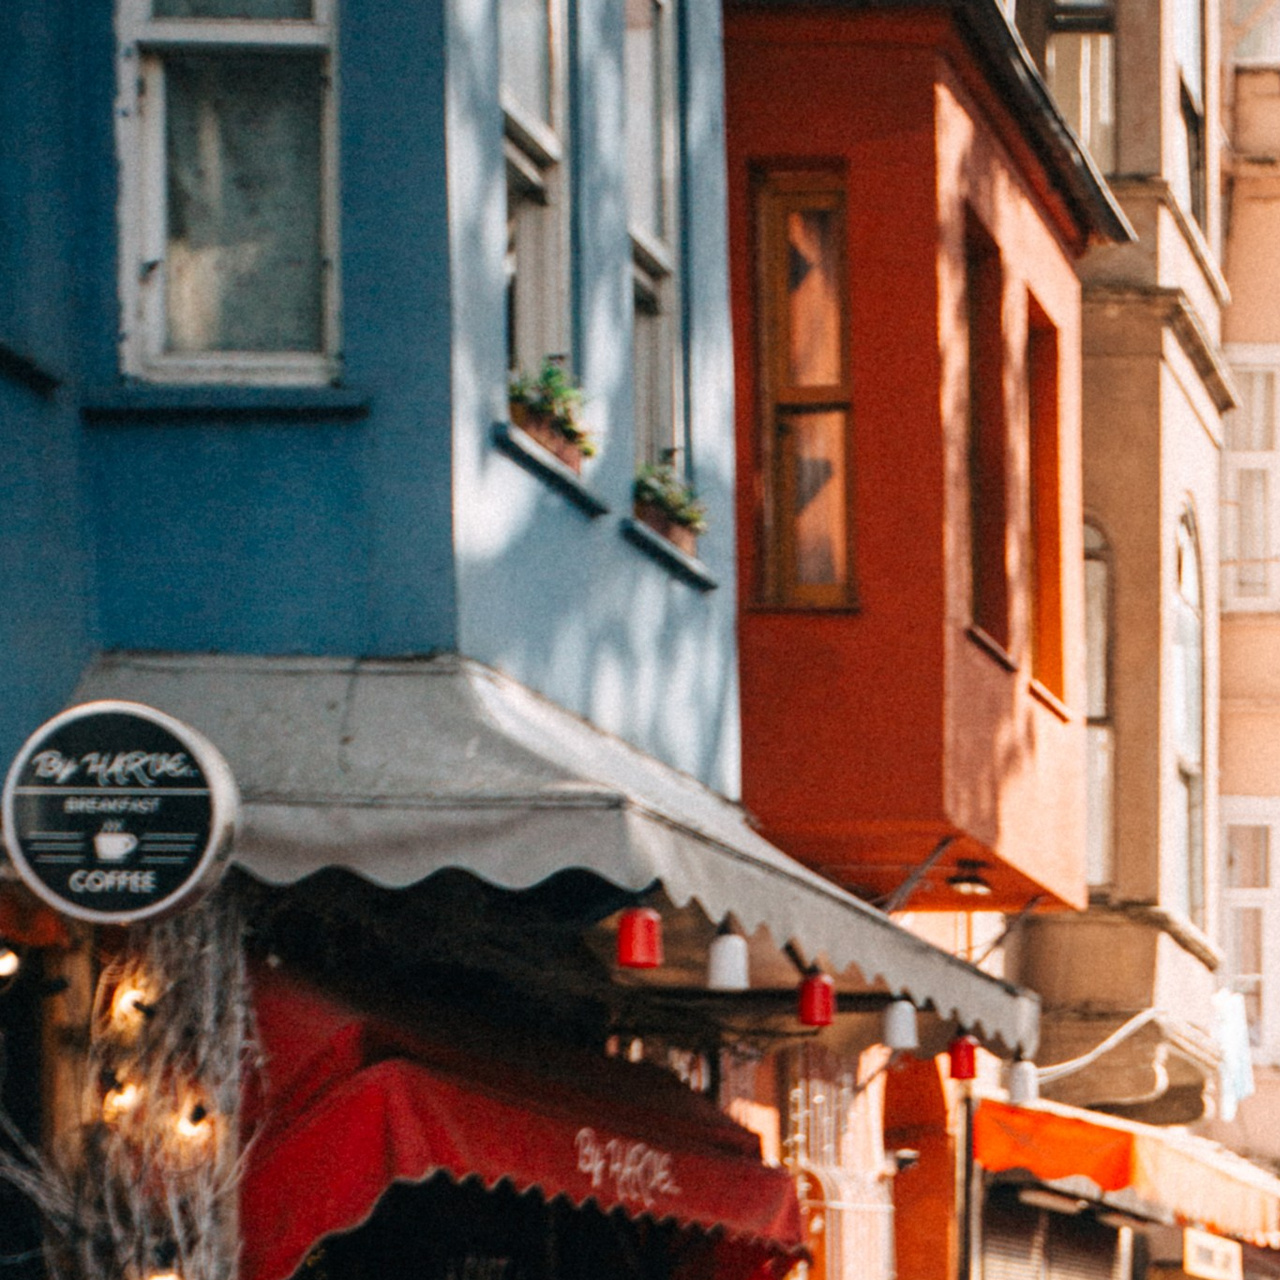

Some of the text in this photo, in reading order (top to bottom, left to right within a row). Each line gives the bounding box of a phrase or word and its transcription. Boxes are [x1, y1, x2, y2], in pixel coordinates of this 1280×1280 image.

[31, 749, 78, 784] By
[63, 796, 162, 815] BREAKFAST
[68, 869, 158, 893] COFFEE
[573, 1126, 605, 1187] By
